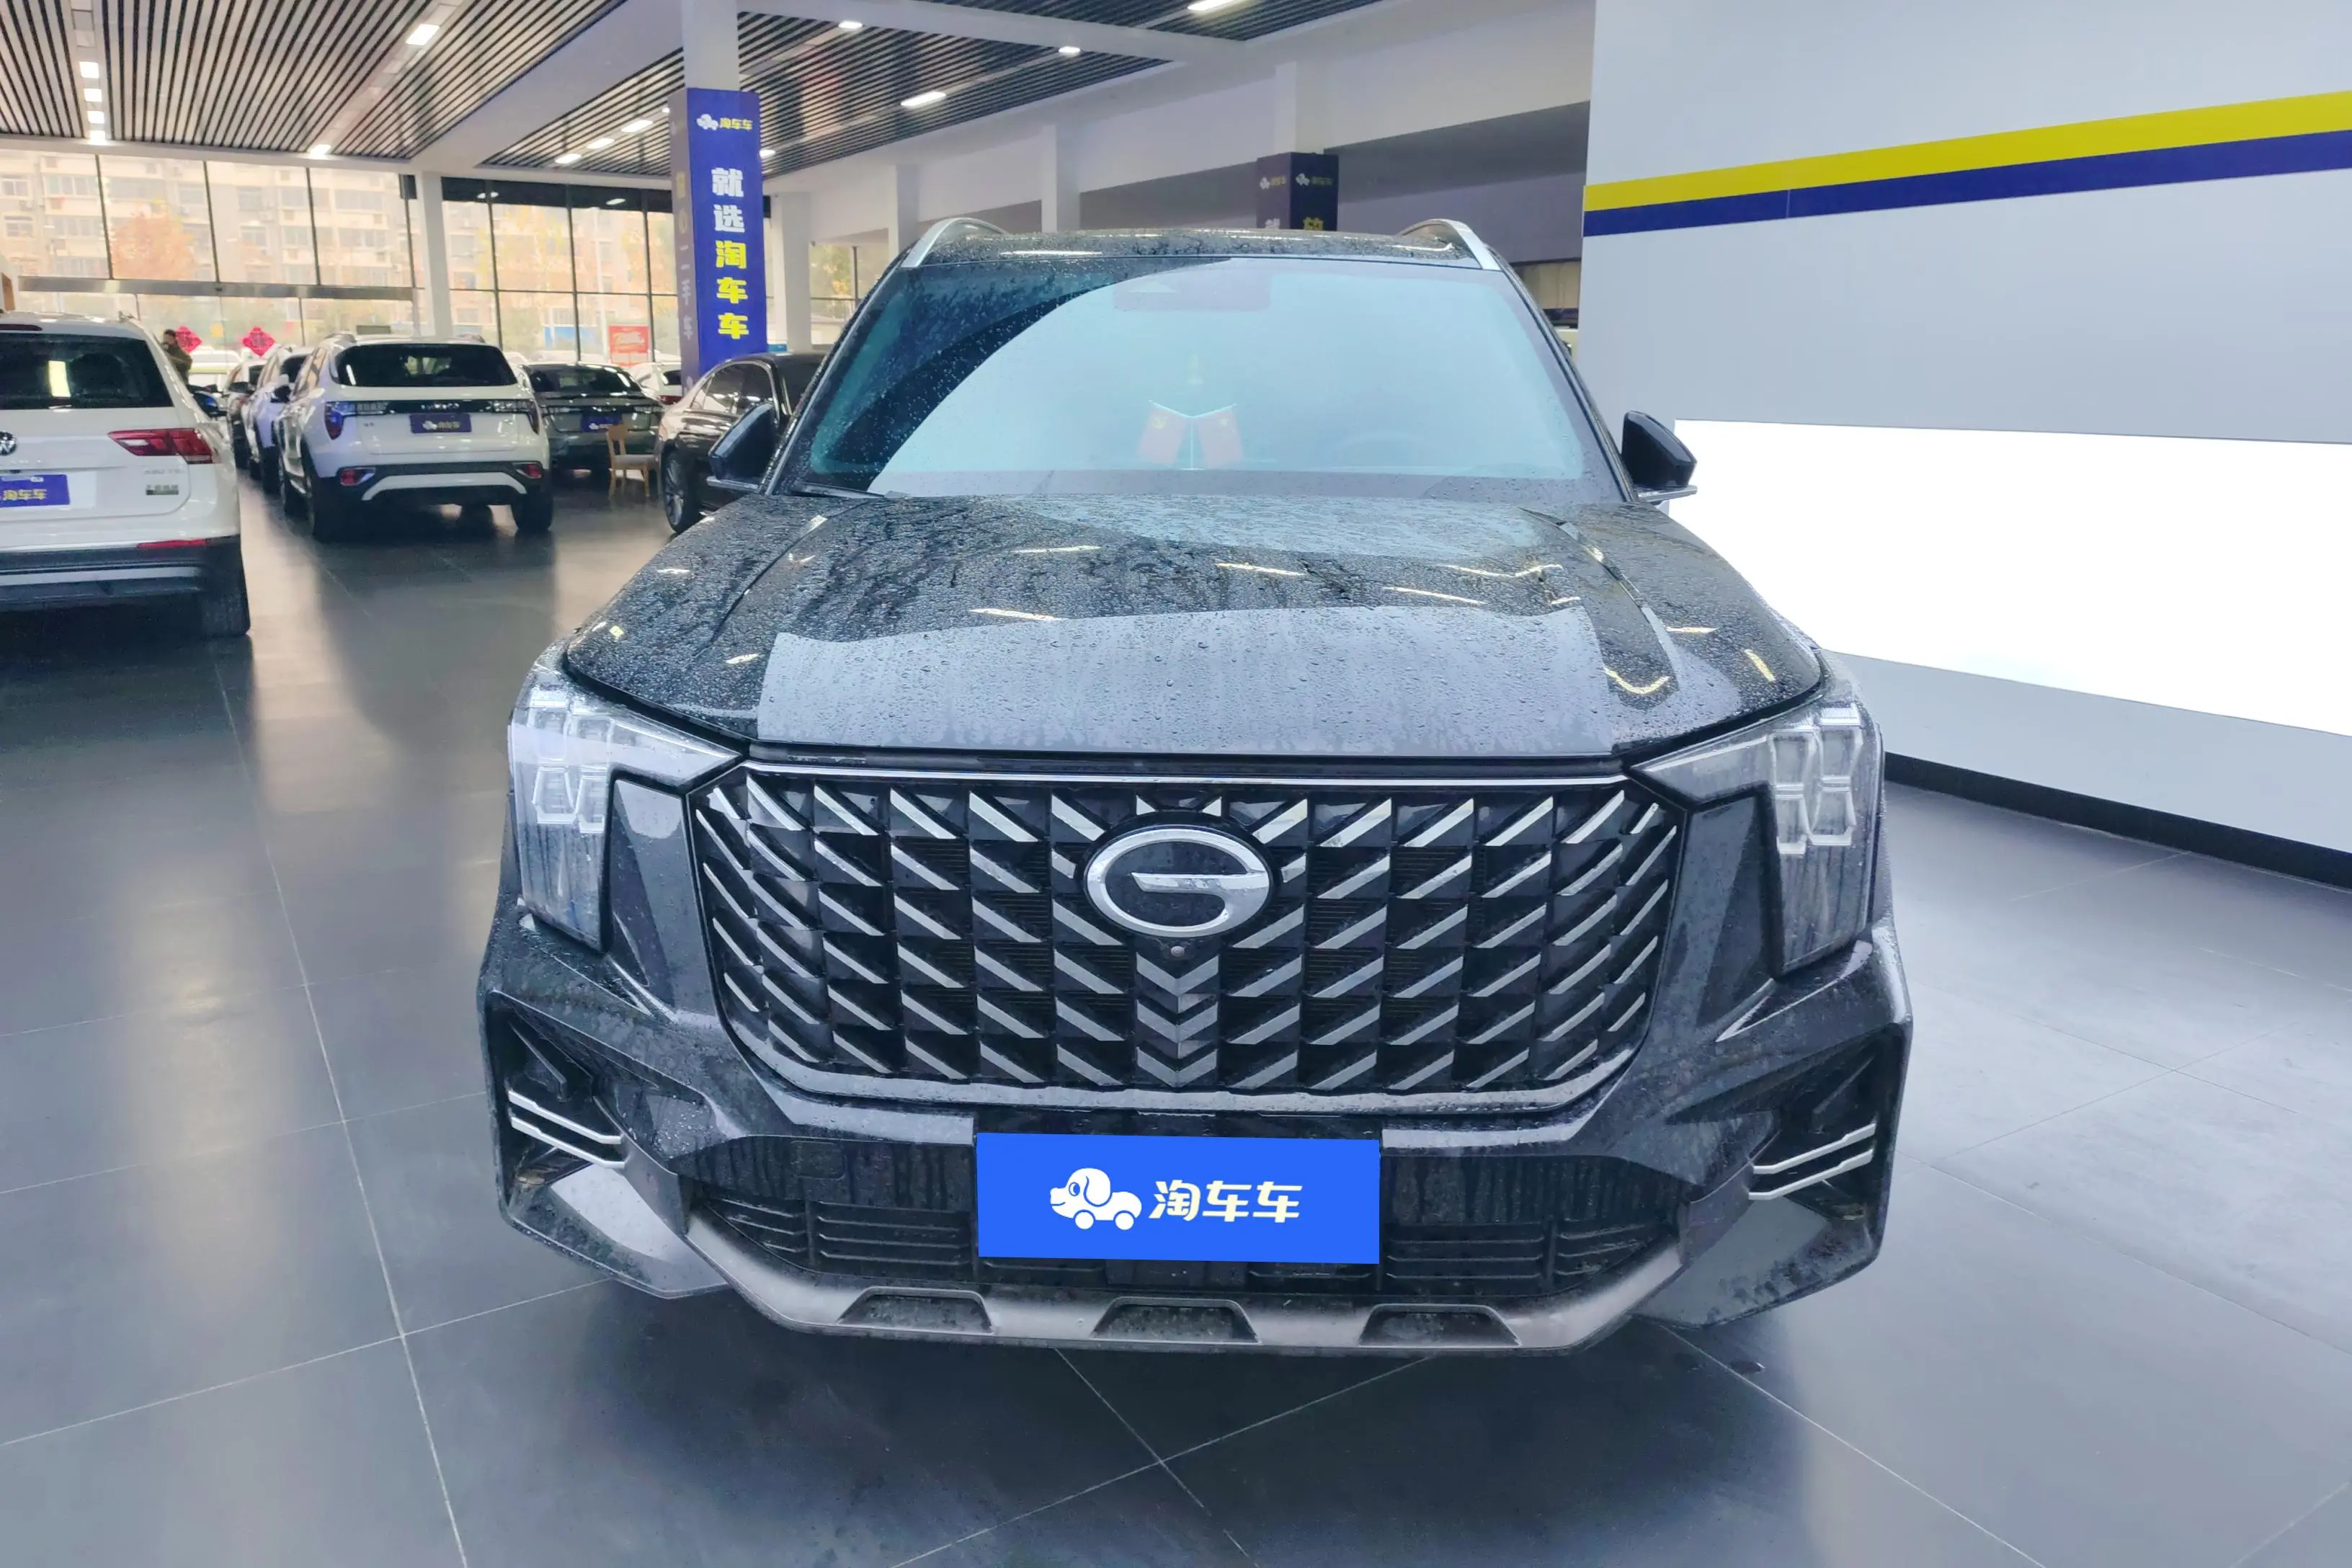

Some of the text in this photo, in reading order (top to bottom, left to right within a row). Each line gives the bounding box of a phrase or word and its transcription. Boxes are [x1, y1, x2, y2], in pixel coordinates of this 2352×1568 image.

[711, 167, 749, 339] 就选淘车车
